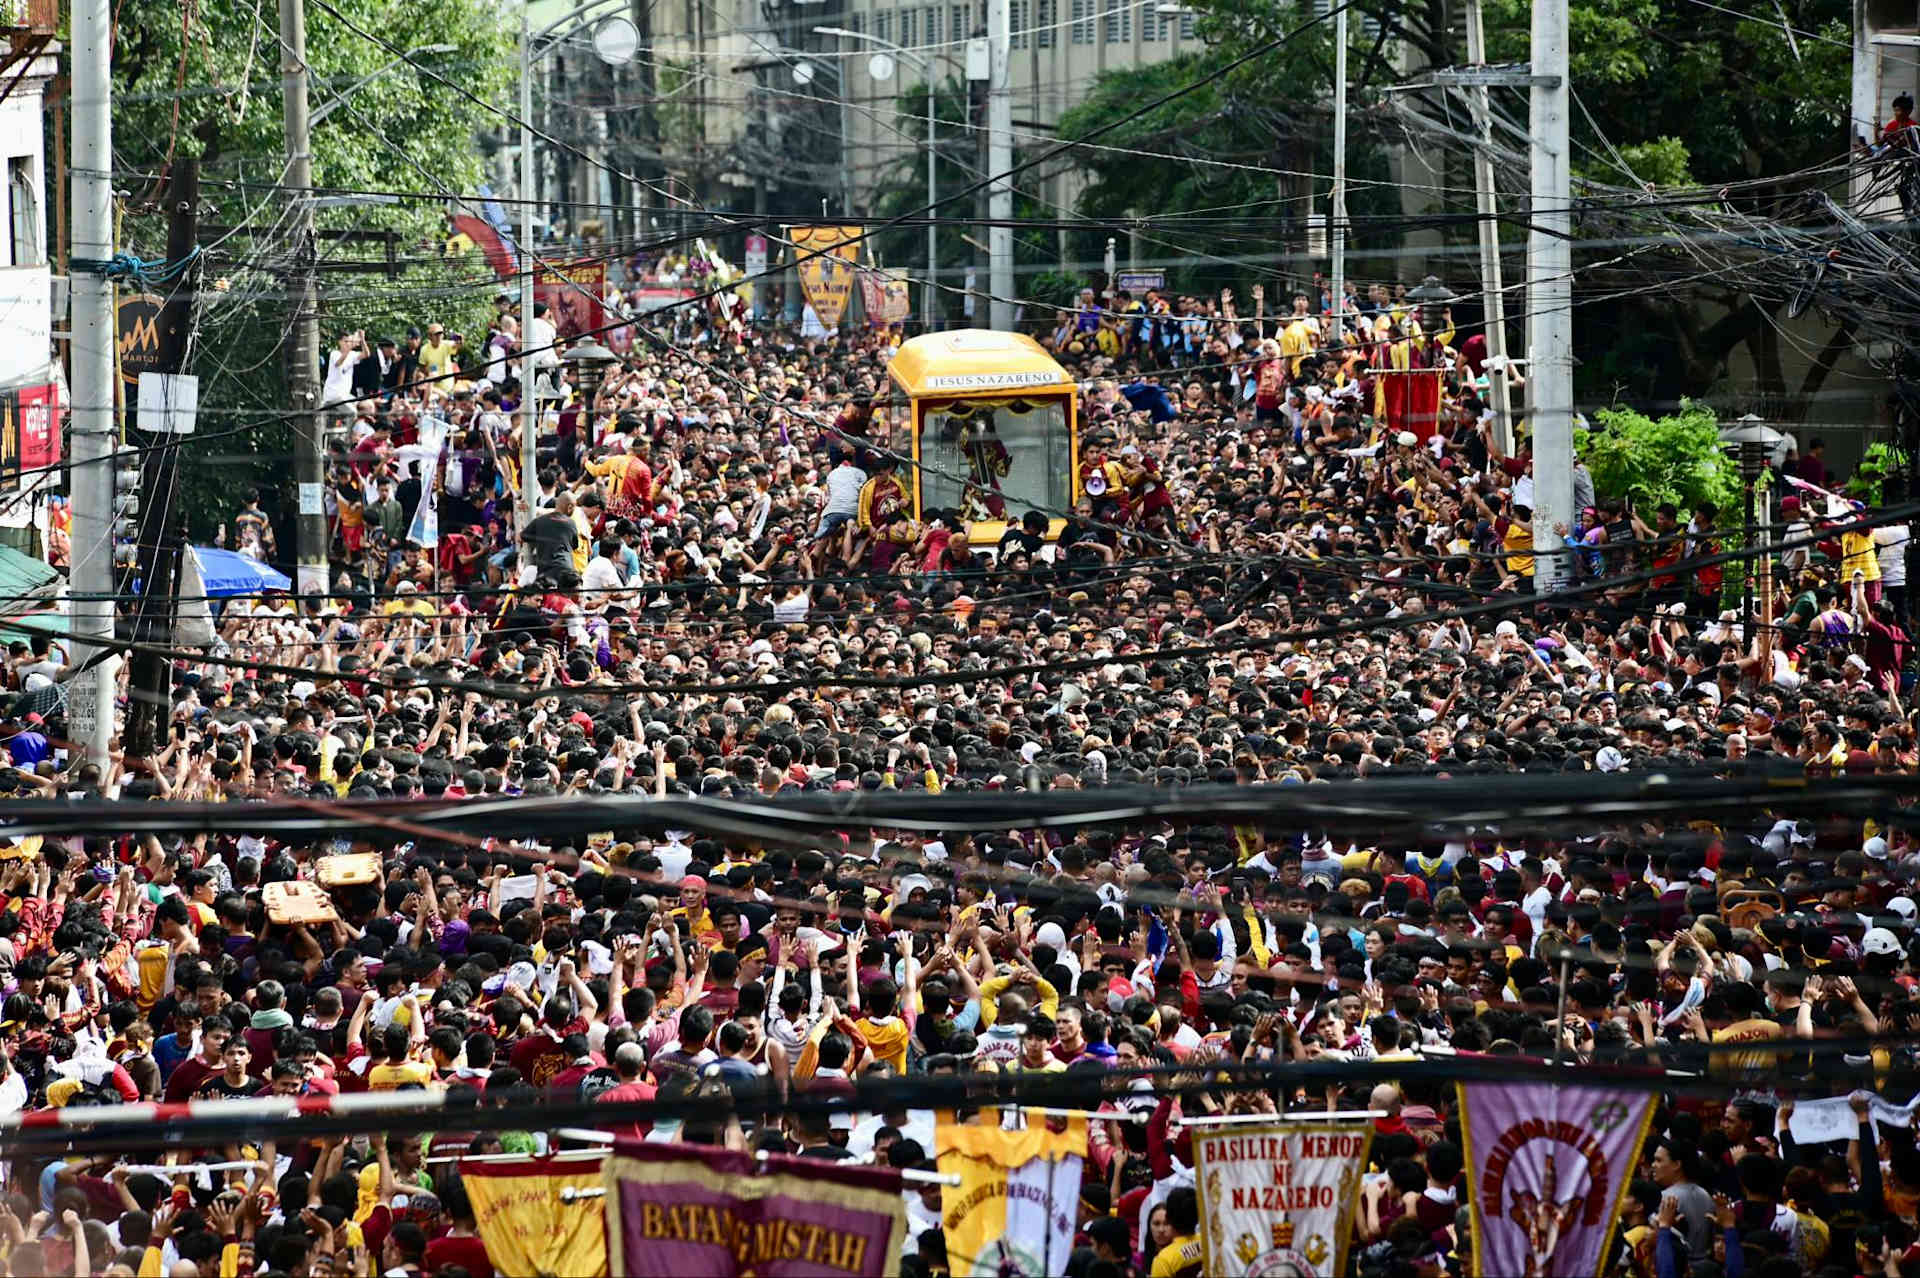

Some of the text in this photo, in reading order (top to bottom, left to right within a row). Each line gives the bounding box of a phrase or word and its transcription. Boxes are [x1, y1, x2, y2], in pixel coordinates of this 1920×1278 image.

[935, 373, 1052, 388] JESUS NAZARENO
[1301, 1136, 1364, 1159] MENOR
[1232, 1186, 1333, 1210] NAZARENO
[641, 1203, 749, 1262] BATANG
[751, 1219, 866, 1272] MISTAH
